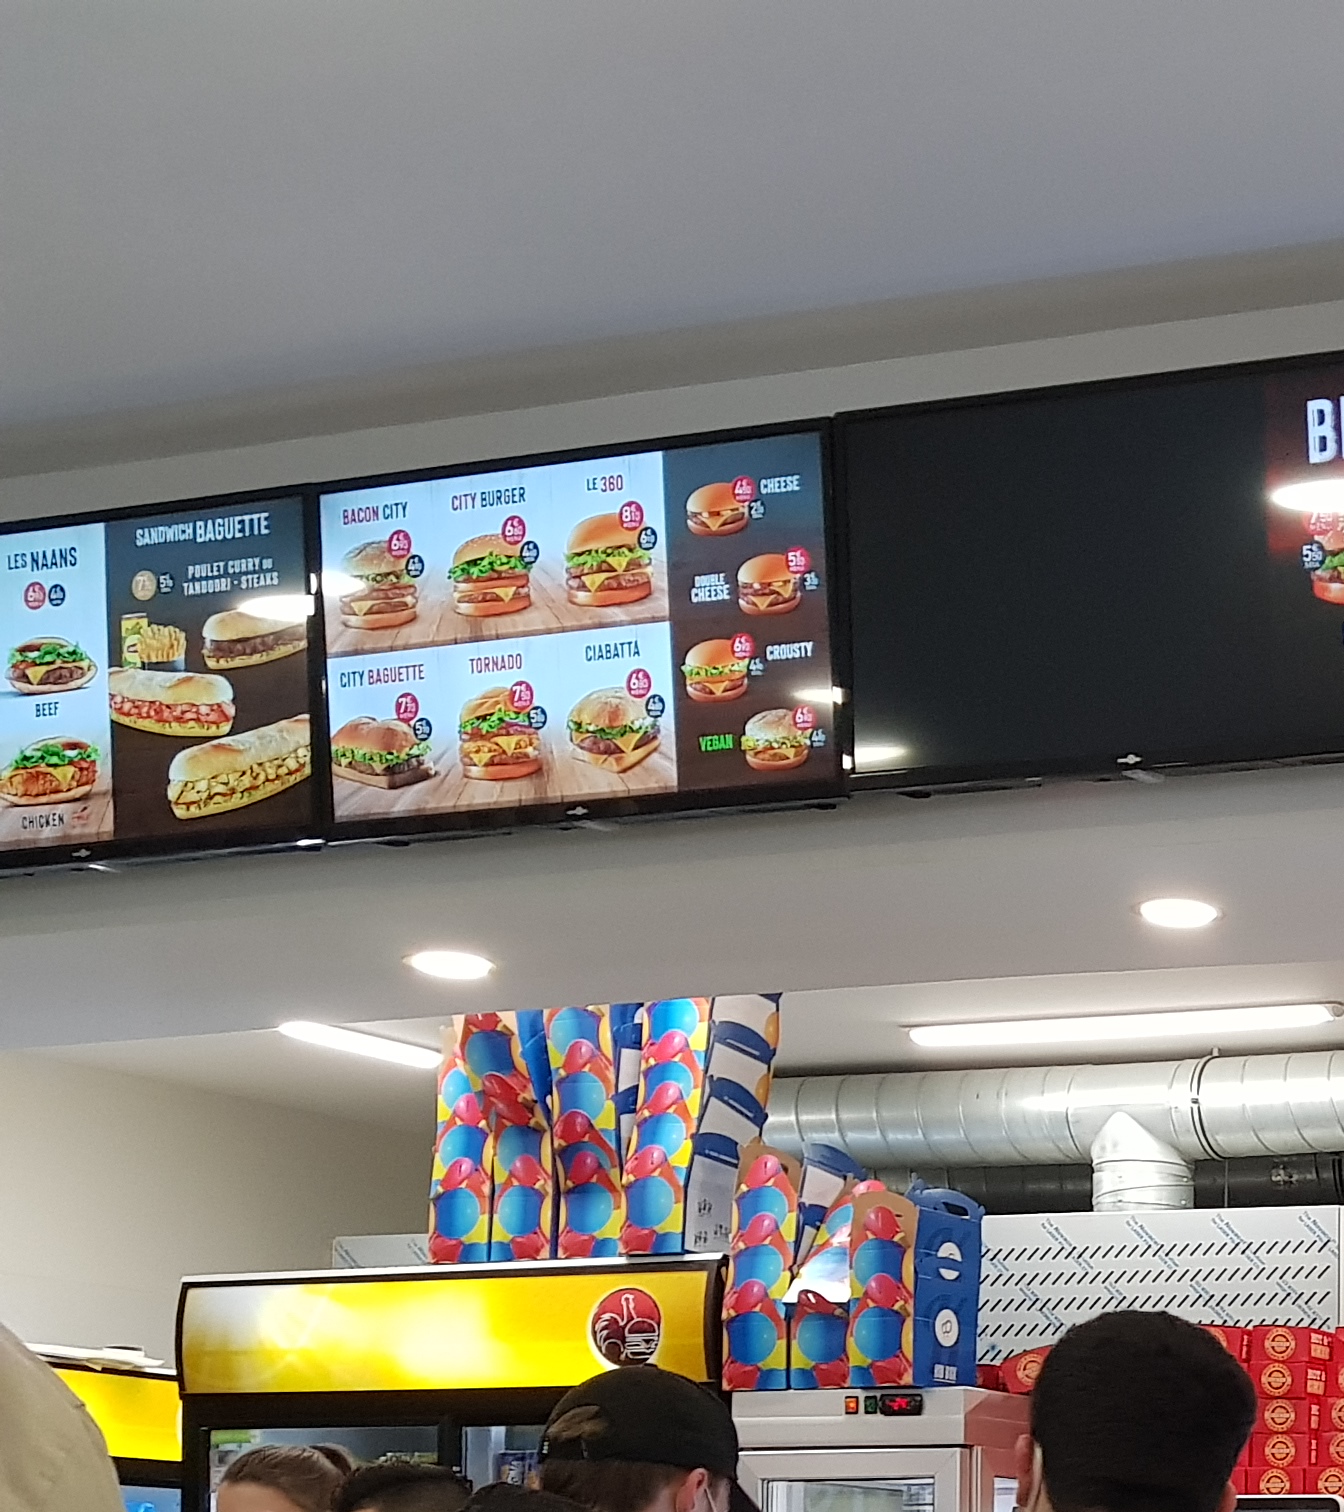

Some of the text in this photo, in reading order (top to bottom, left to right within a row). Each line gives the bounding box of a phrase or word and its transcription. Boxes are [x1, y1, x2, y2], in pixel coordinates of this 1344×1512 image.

[586, 474, 624, 493] LE 360
[760, 475, 800, 495] CHEESE
[452, 486, 526, 511] CITY BURGER
[343, 501, 408, 525] BACON CITY
[136, 513, 270, 546] SANDWICH BAGUETTE
[7, 547, 77, 572] LES NAANS
[188, 561, 225, 579] POULET
[228, 558, 260, 574] CURRY
[241, 572, 279, 589] STEAKS
[694, 573, 726, 587] DOUBLE
[691, 585, 730, 603] CHEESE
[585, 640, 640, 662] CIABATTA
[766, 641, 814, 661] CROUSTY
[469, 653, 523, 674] TORNADO
[340, 664, 425, 688] CITY BAGUETTE
[35, 702, 60, 717] BEEF
[700, 734, 734, 751] VEGAN
[21, 813, 65, 829] CHICKEN
